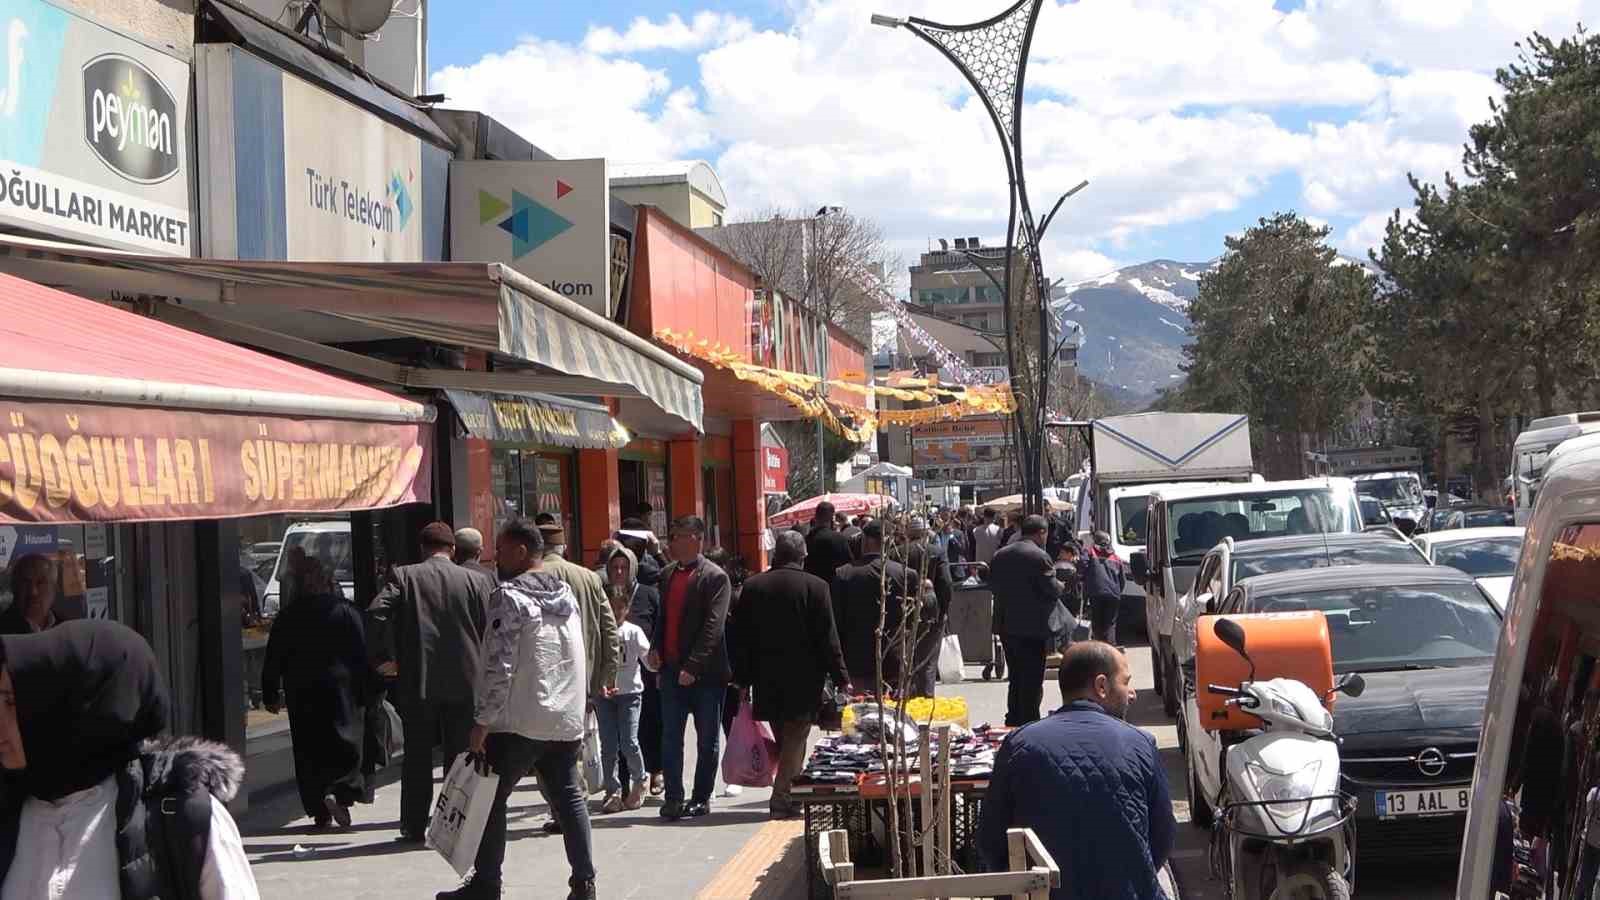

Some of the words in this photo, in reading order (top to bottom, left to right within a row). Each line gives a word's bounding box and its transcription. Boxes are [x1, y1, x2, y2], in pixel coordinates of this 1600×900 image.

[93, 88, 172, 154] peyman
[108, 202, 188, 246] MARKET
[306, 167, 337, 214] Türk
[341, 180, 393, 232] Telekom
[1387, 794, 1405, 812] 13
[1417, 791, 1448, 811] AAL
